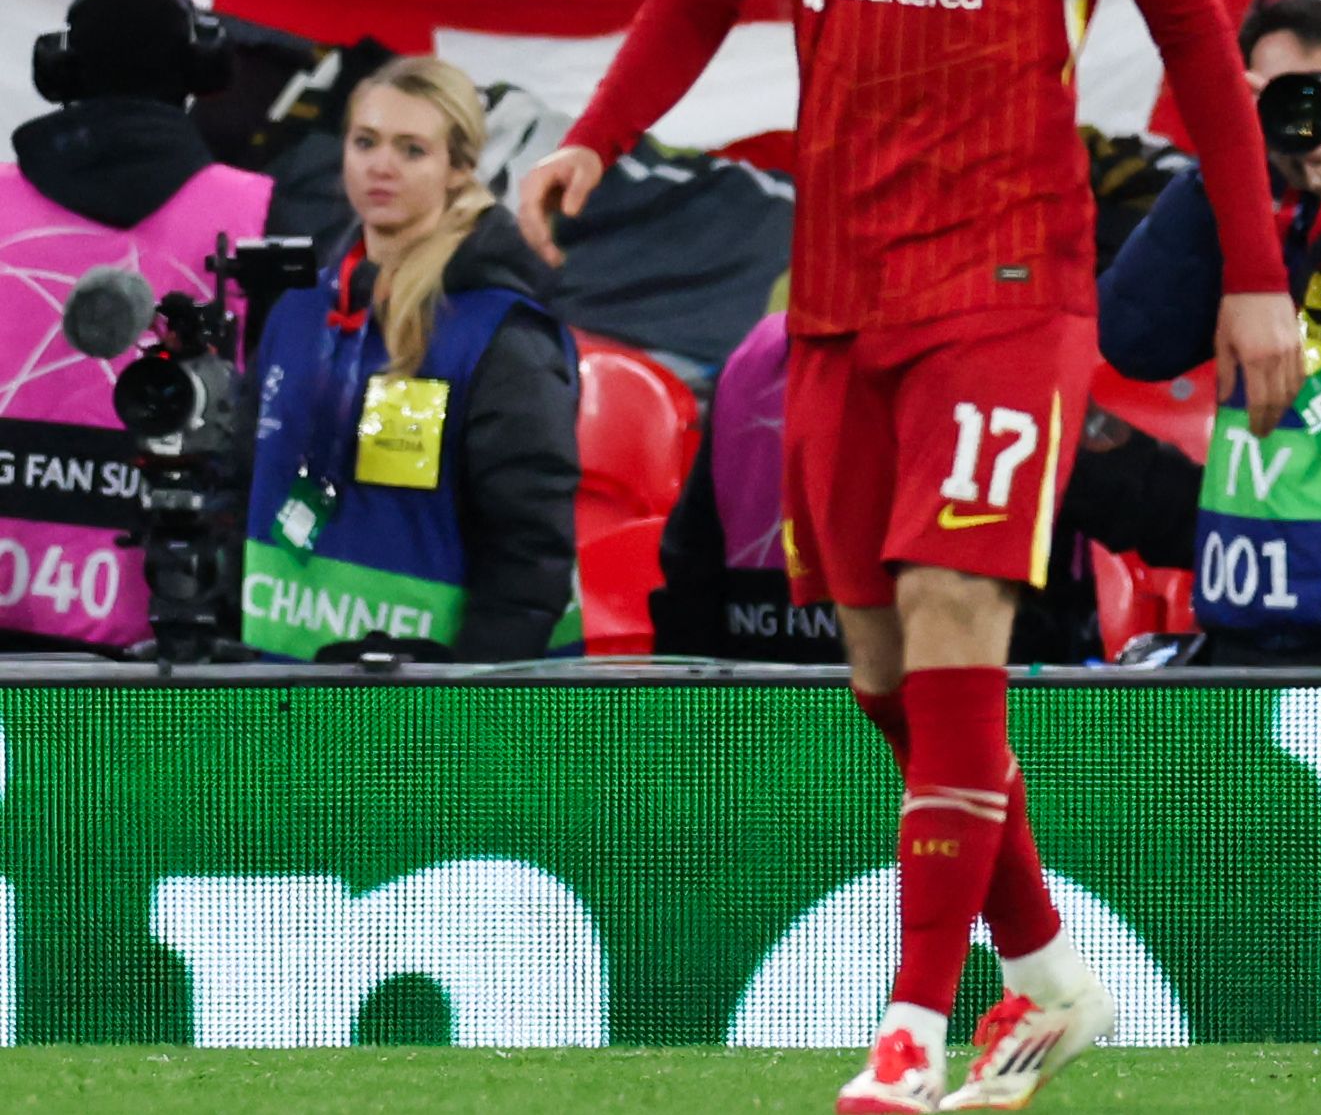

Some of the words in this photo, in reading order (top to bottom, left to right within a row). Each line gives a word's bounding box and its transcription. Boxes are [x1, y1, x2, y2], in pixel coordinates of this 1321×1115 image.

[25, 453, 95, 492] FAN
[940, 401, 1040, 508] 17
[1225, 426, 1293, 502] TV
[1201, 530, 1299, 610] 001
